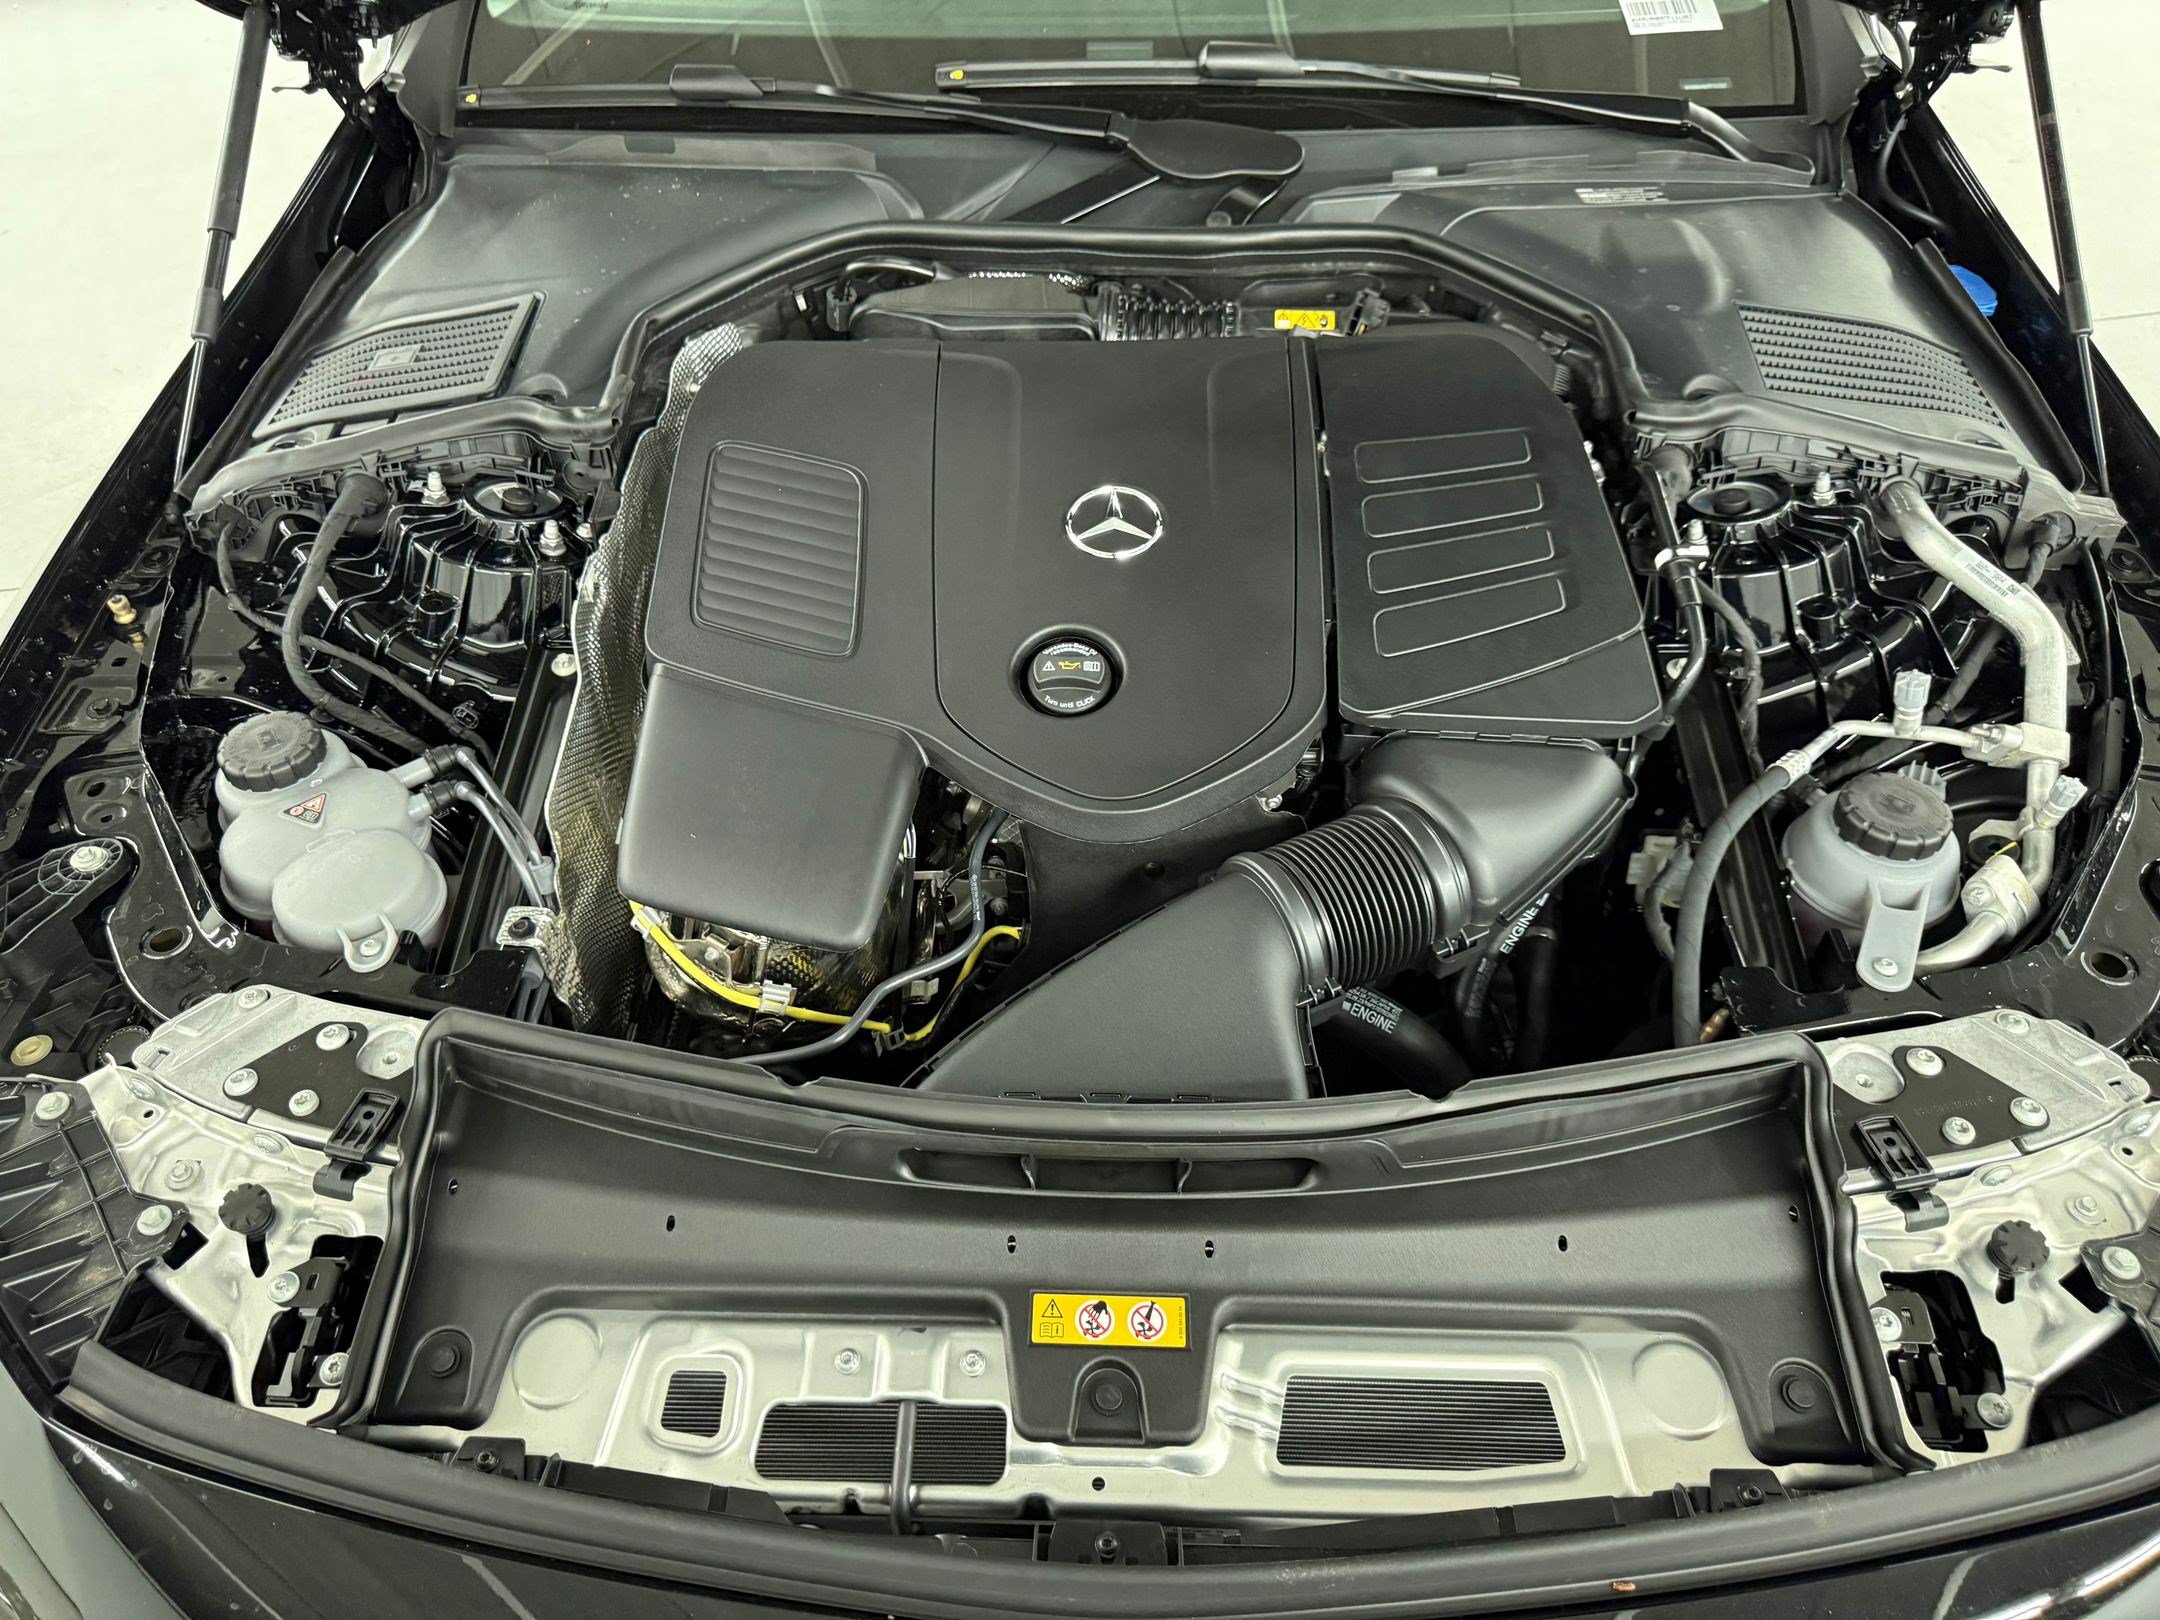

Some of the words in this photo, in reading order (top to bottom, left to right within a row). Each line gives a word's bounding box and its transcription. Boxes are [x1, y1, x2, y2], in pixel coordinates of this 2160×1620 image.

[1042, 643, 1089, 654] Mercedes-Benz
[1044, 695, 1058, 706] Turn
[1076, 696, 1095, 707] CLICK
[1499, 907, 1539, 954] ENGINE
[1350, 1002, 1397, 1034] ENGINE
